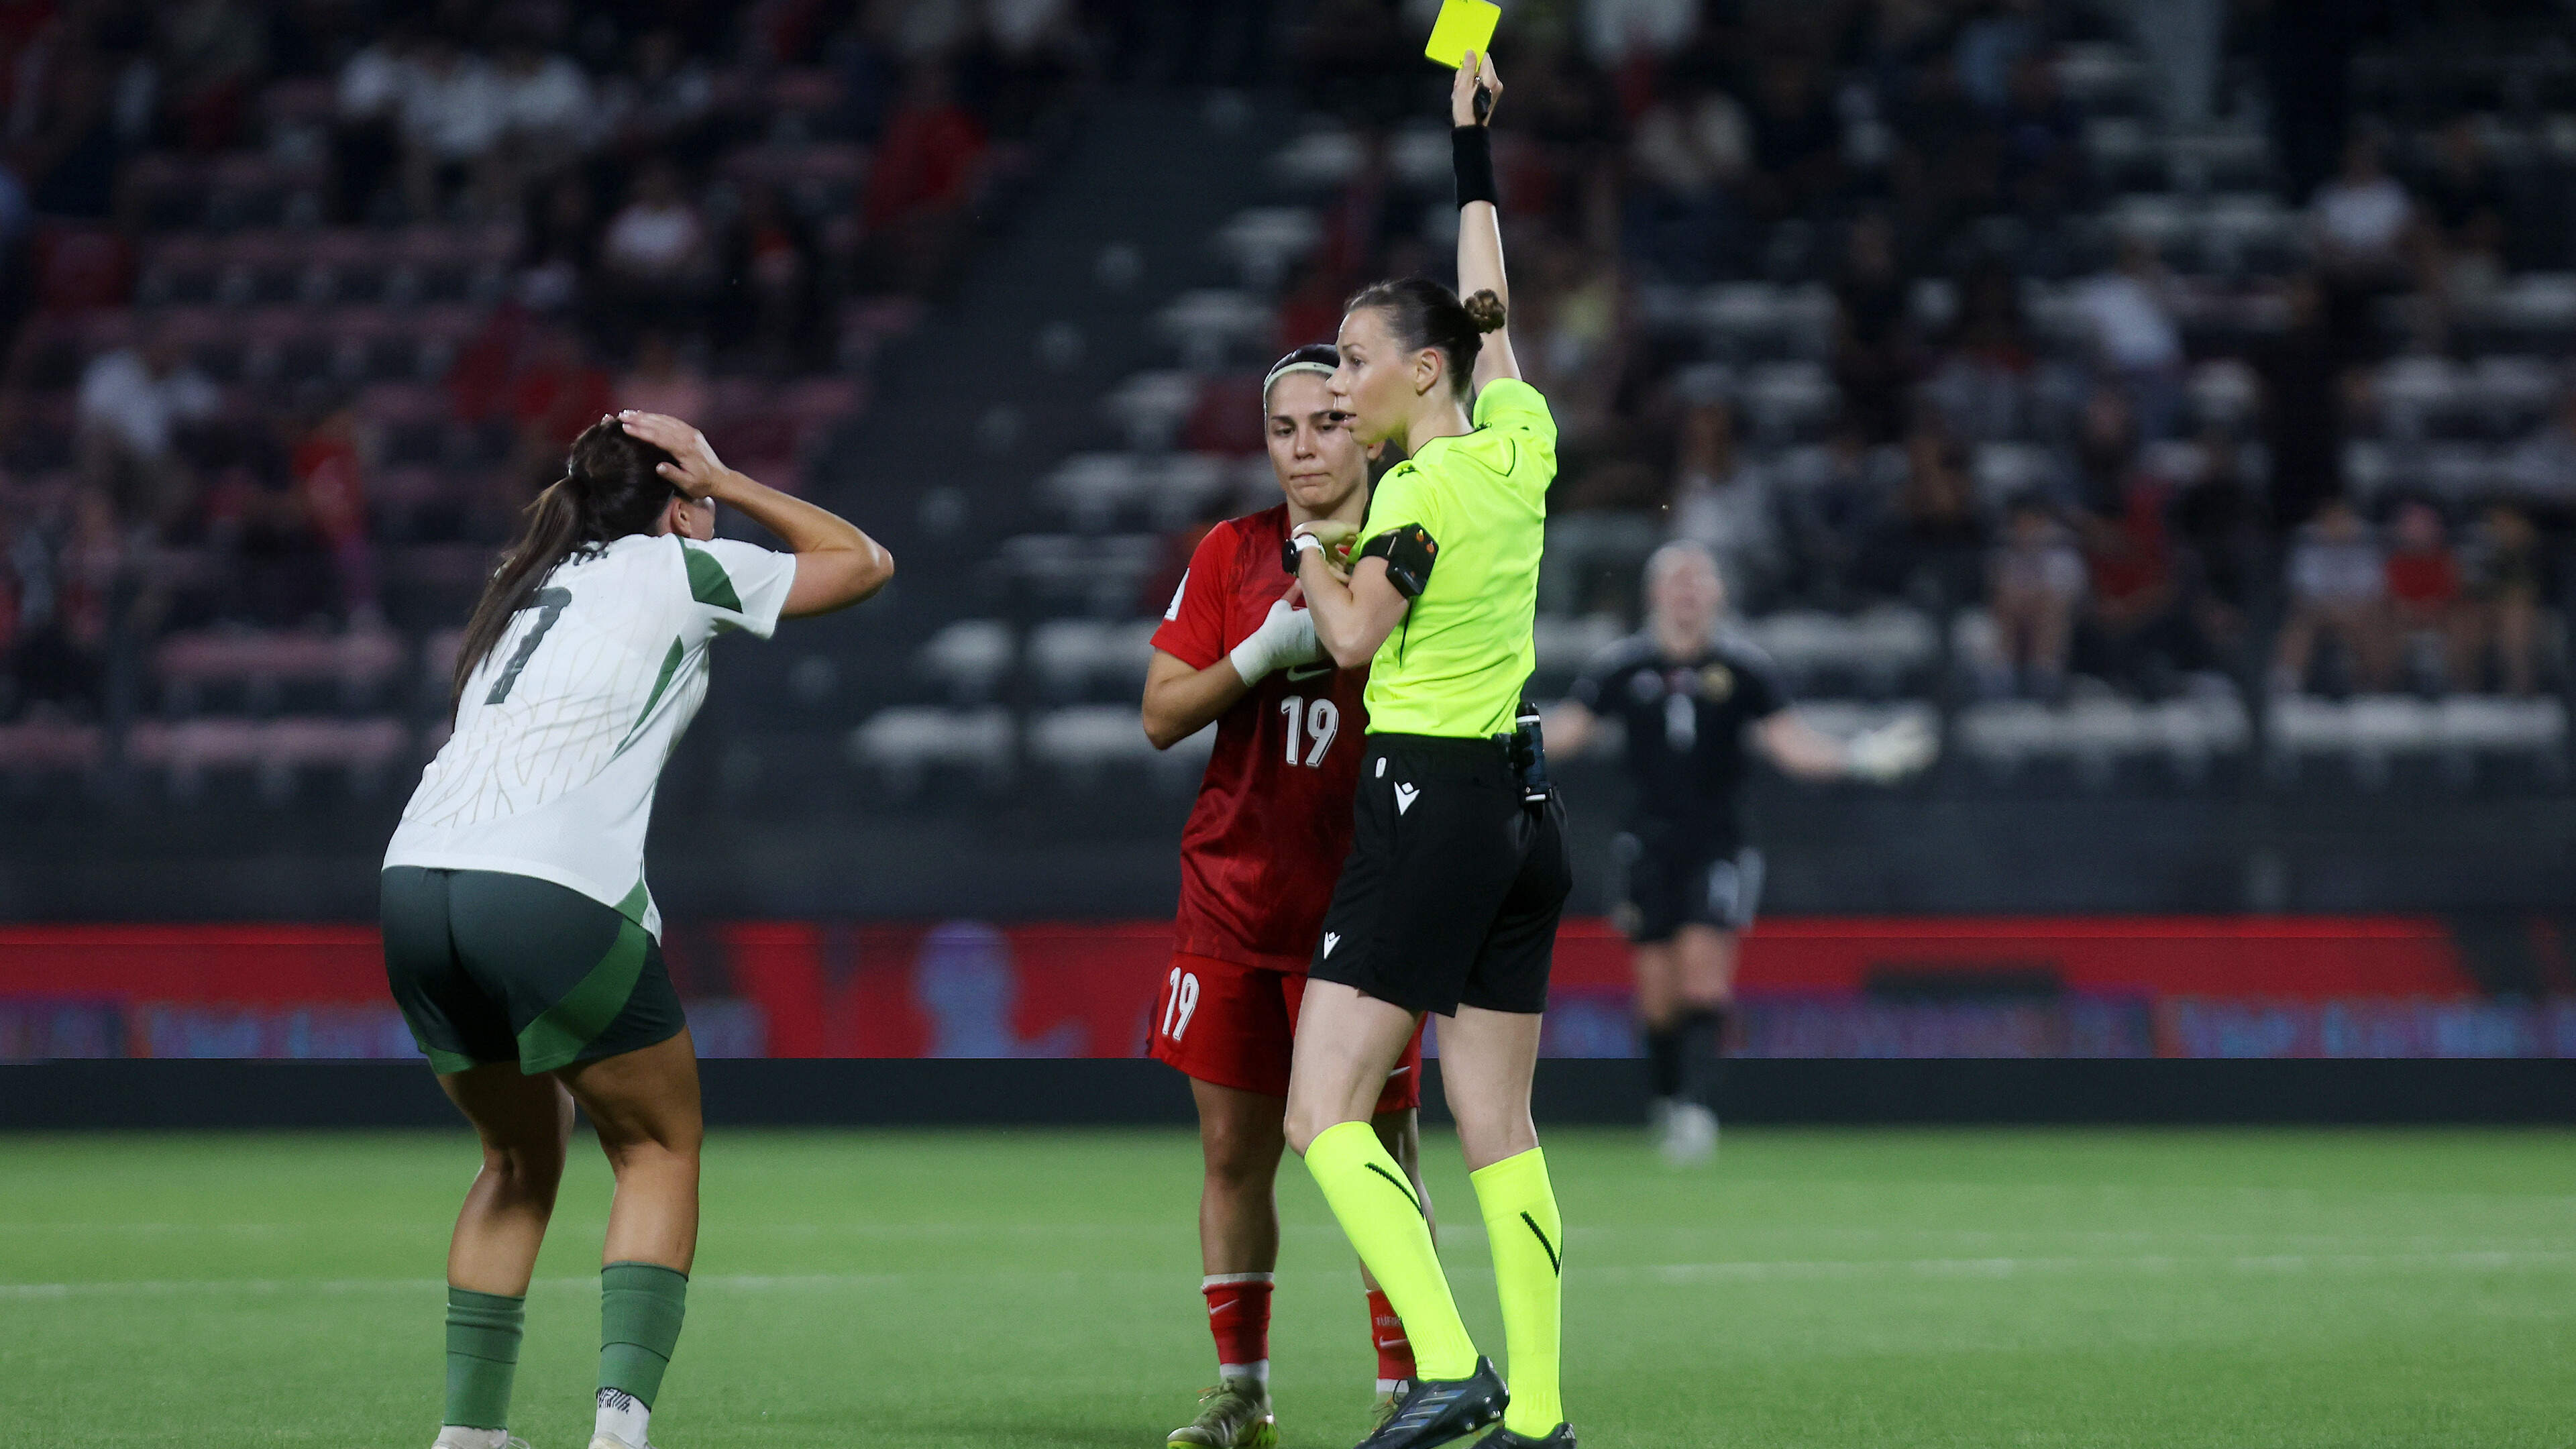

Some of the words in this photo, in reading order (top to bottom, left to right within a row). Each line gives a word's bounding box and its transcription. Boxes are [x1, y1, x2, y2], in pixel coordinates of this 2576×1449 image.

[483, 586, 572, 706] 7
[1281, 695, 1340, 767] 19
[1162, 966, 1199, 1041] 19
